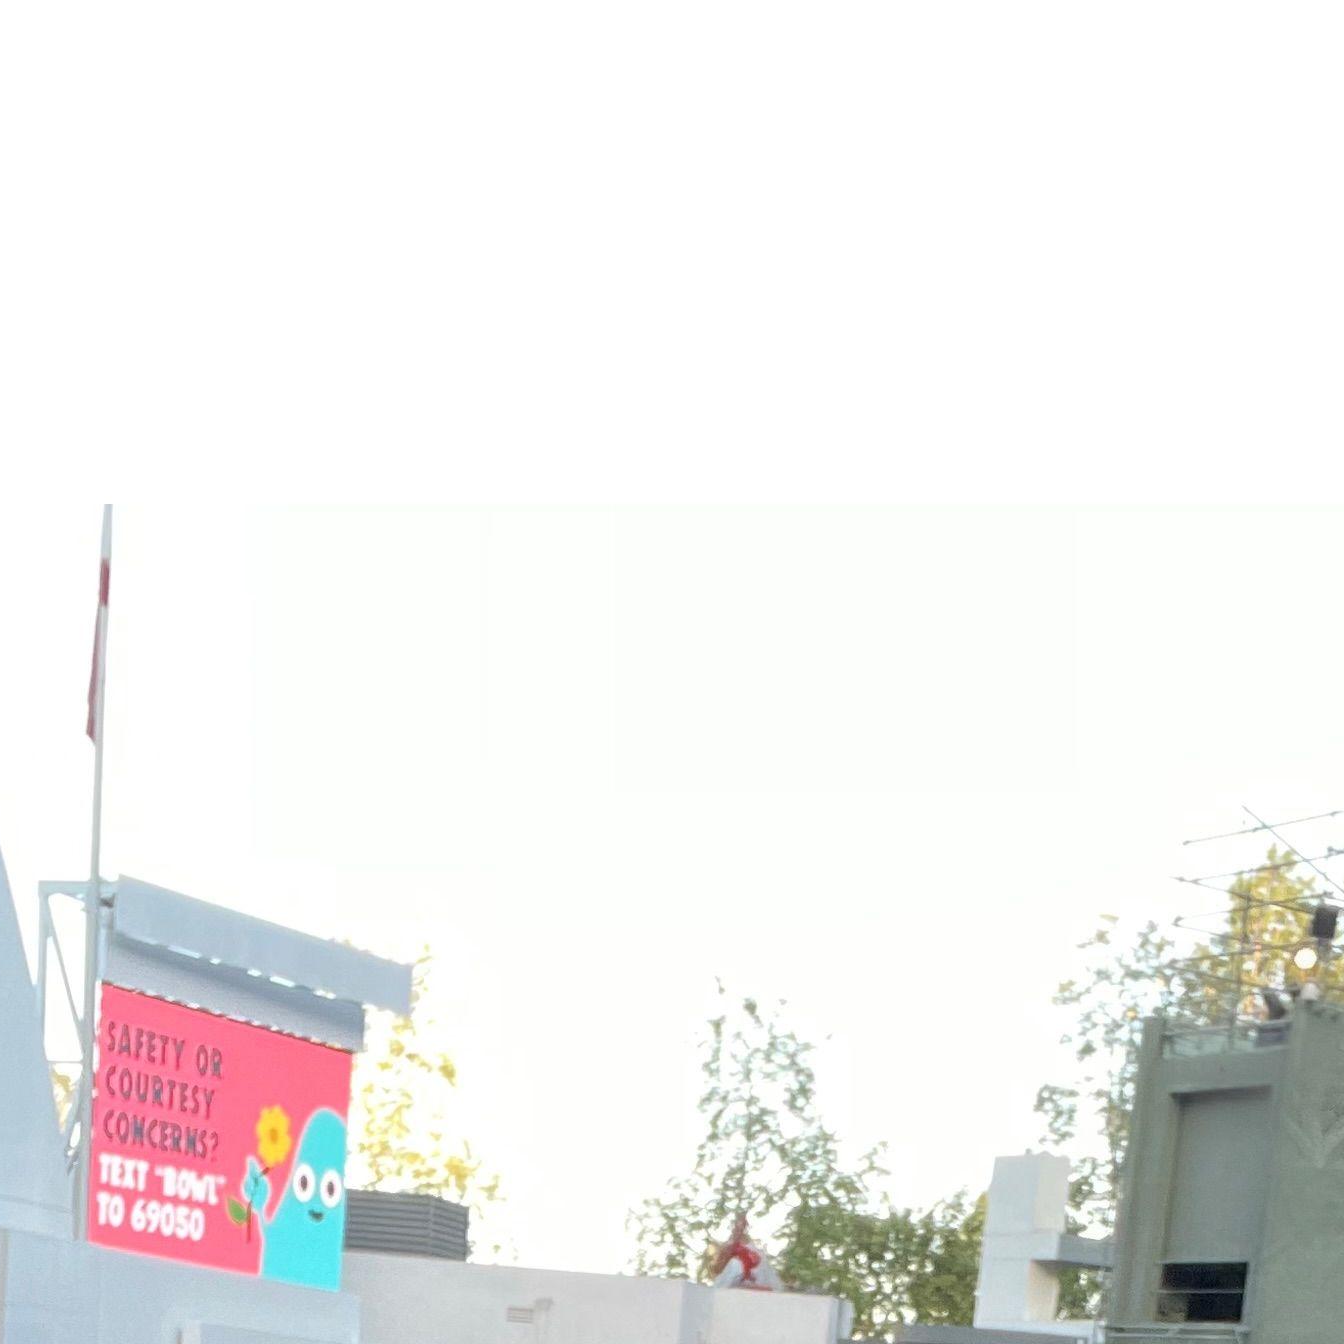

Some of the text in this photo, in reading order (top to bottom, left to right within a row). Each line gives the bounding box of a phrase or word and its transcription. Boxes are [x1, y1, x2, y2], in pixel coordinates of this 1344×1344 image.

[108, 1020, 223, 1079] SAFETY OR
[105, 1066, 215, 1119] COURTESY
[103, 1109, 219, 1162] CONCERNS?
[99, 1152, 149, 1192] TEXT
[97, 1191, 205, 1242] TO 69050
